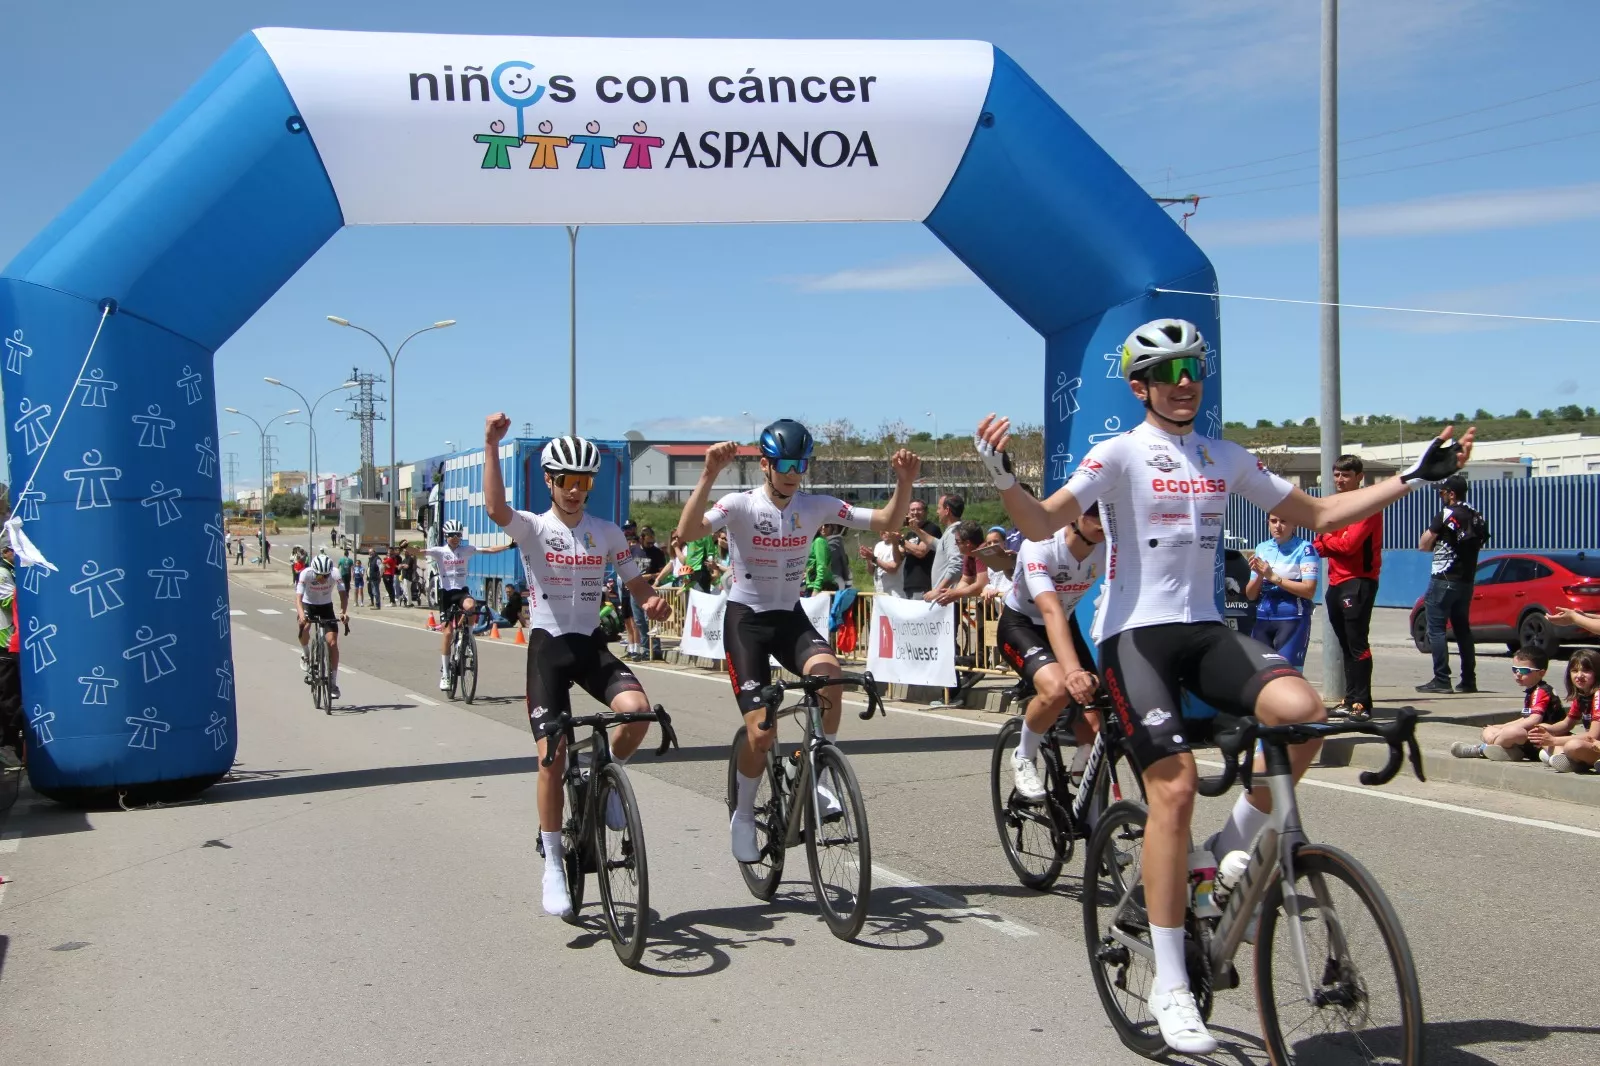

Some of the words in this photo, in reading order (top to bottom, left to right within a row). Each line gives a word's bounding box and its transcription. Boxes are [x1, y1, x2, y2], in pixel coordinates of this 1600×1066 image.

[596, 75, 690, 104] con
[708, 68, 877, 103] cáncer
[665, 130, 879, 169] ASPANOA
[1152, 475, 1226, 494] ecotisa
[752, 534, 807, 547] ecotisa
[545, 552, 603, 565] ecotisa
[906, 642, 938, 661] Huesca
